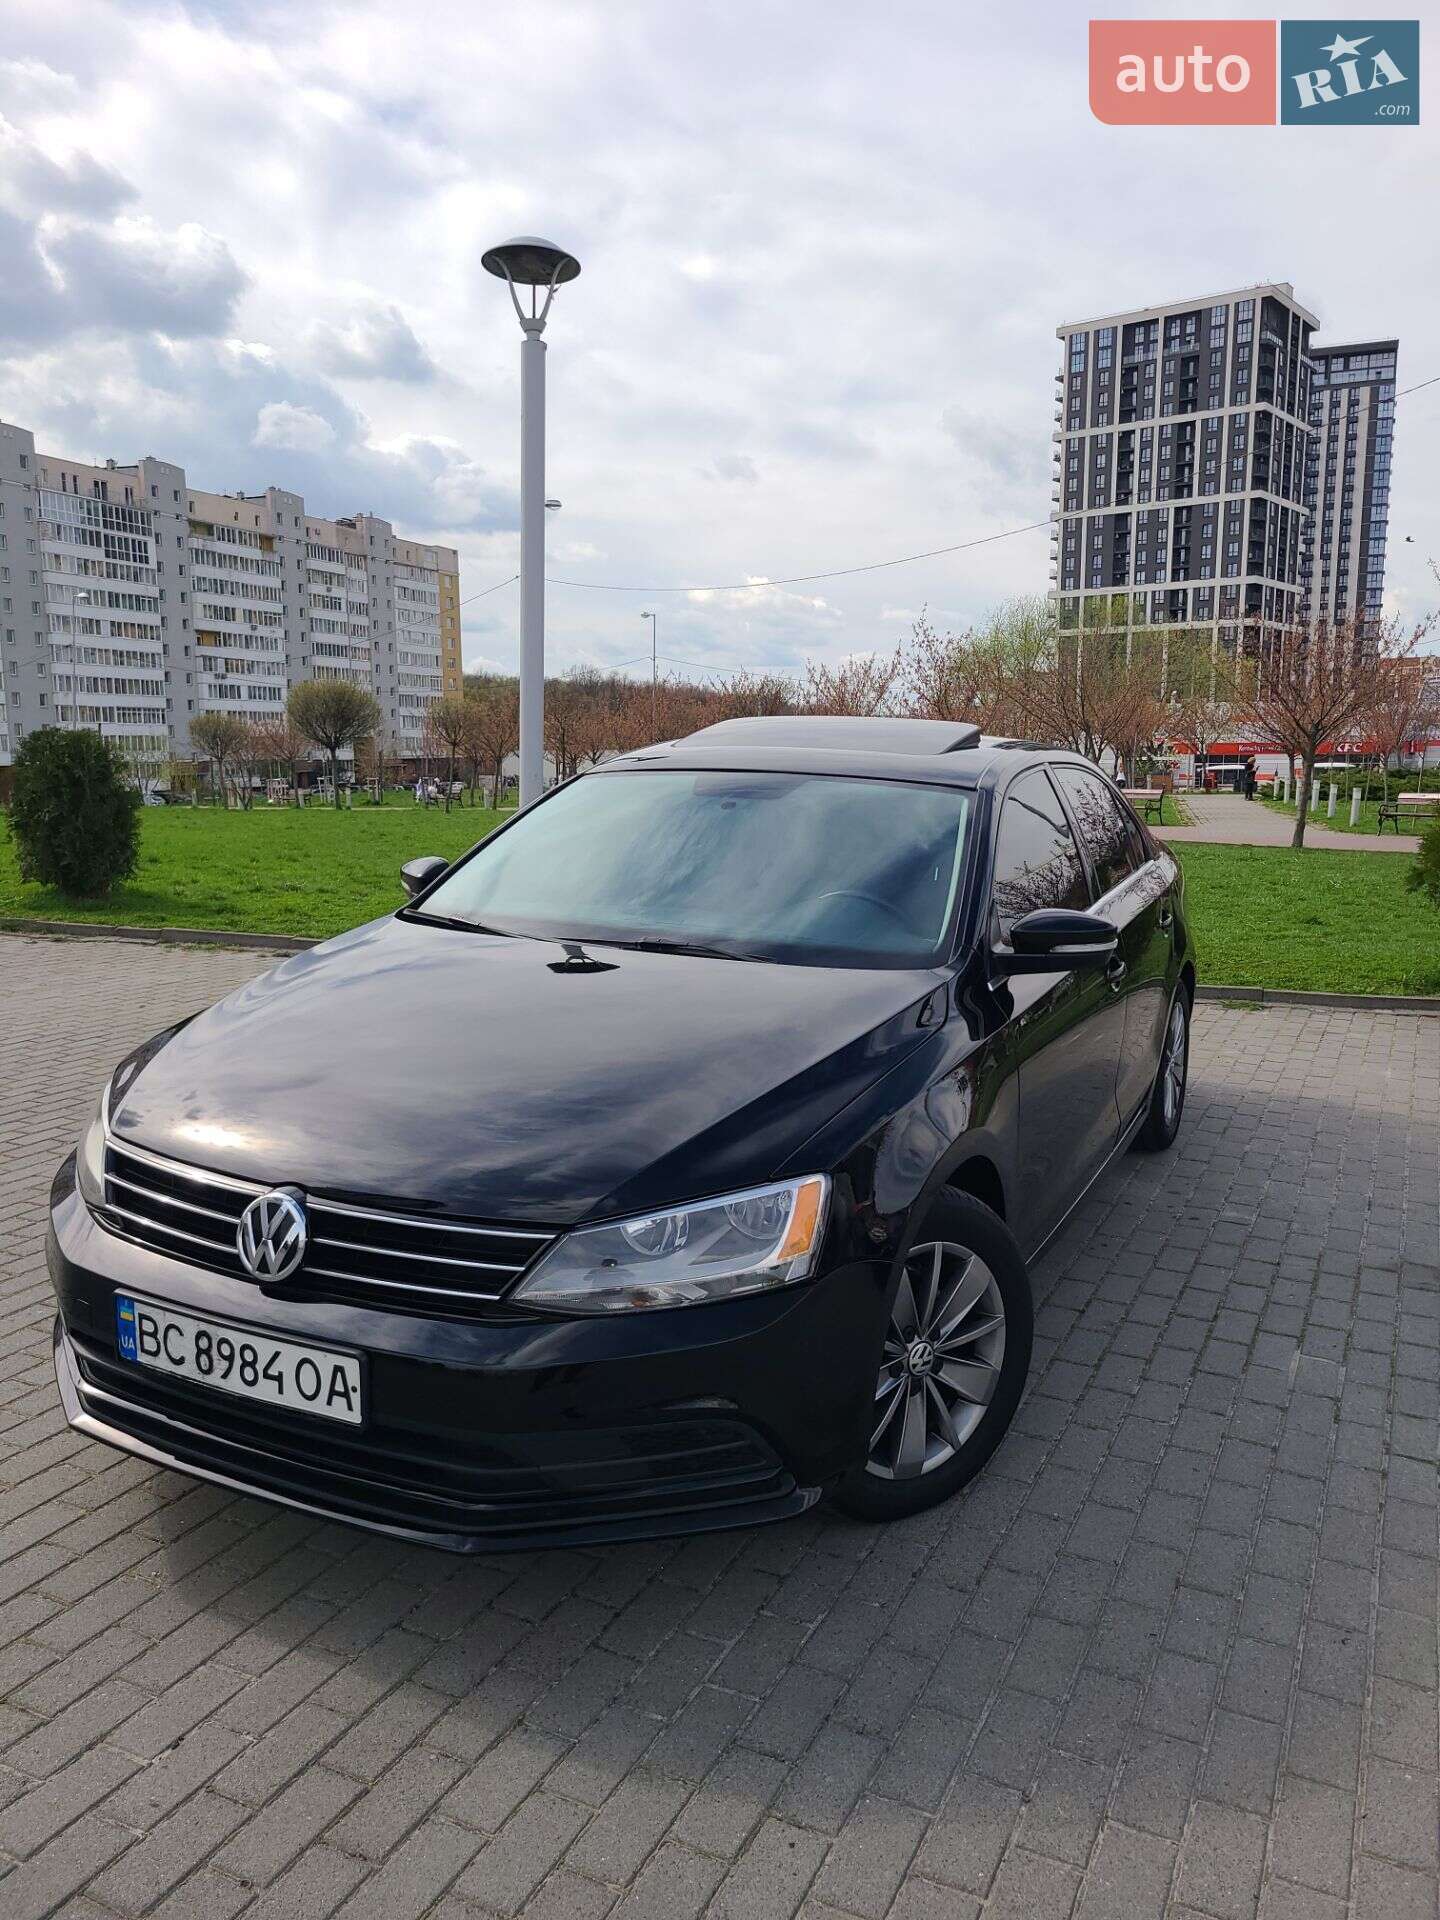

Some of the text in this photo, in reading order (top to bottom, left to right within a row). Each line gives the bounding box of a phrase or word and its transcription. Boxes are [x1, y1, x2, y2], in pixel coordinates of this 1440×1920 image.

[120, 1333, 136, 1351] UA
[138, 1312, 354, 1412] BC 8984 OA
